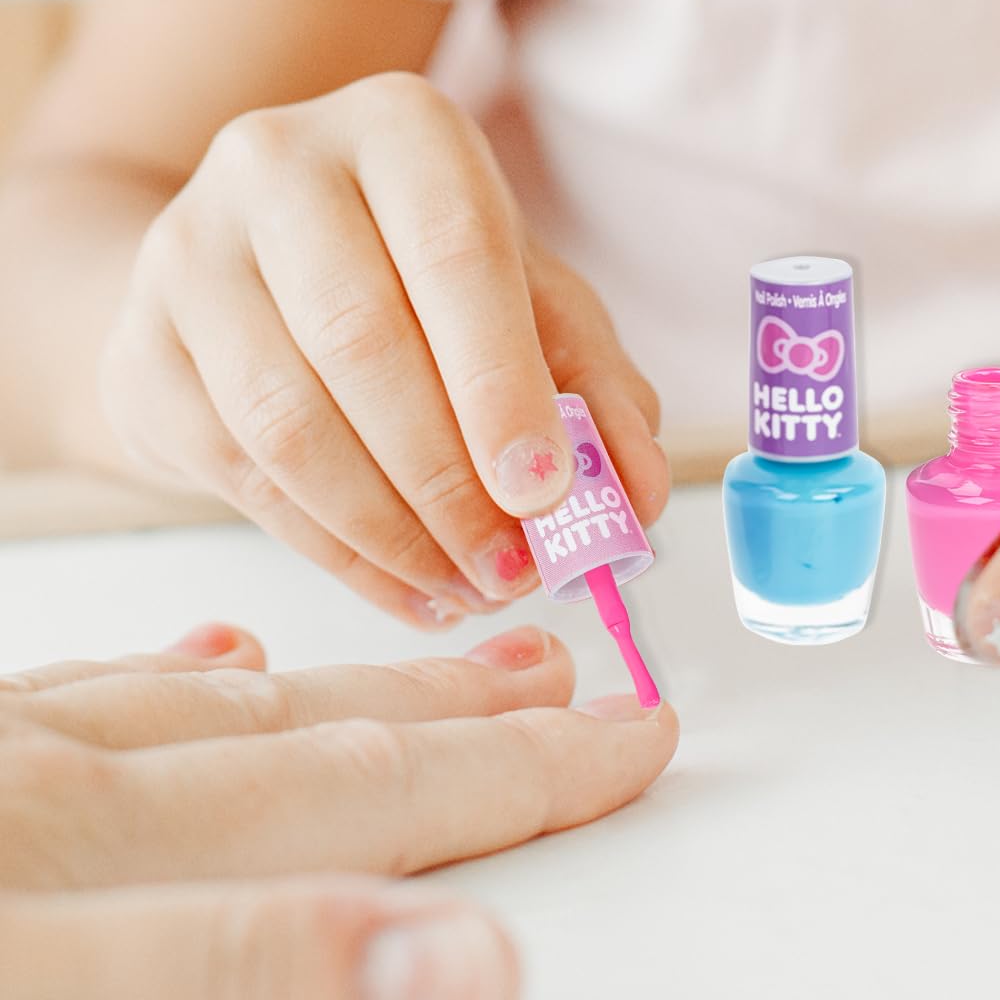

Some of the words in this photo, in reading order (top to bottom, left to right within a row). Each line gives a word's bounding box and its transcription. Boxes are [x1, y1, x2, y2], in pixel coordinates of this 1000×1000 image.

[766, 292, 787, 307] Polish
[792, 294, 817, 308] Vernis
[753, 381, 844, 413] HELLO
[754, 409, 843, 442] KITTY
[534, 486, 621, 537] HELLO
[544, 510, 629, 563] KITTY
